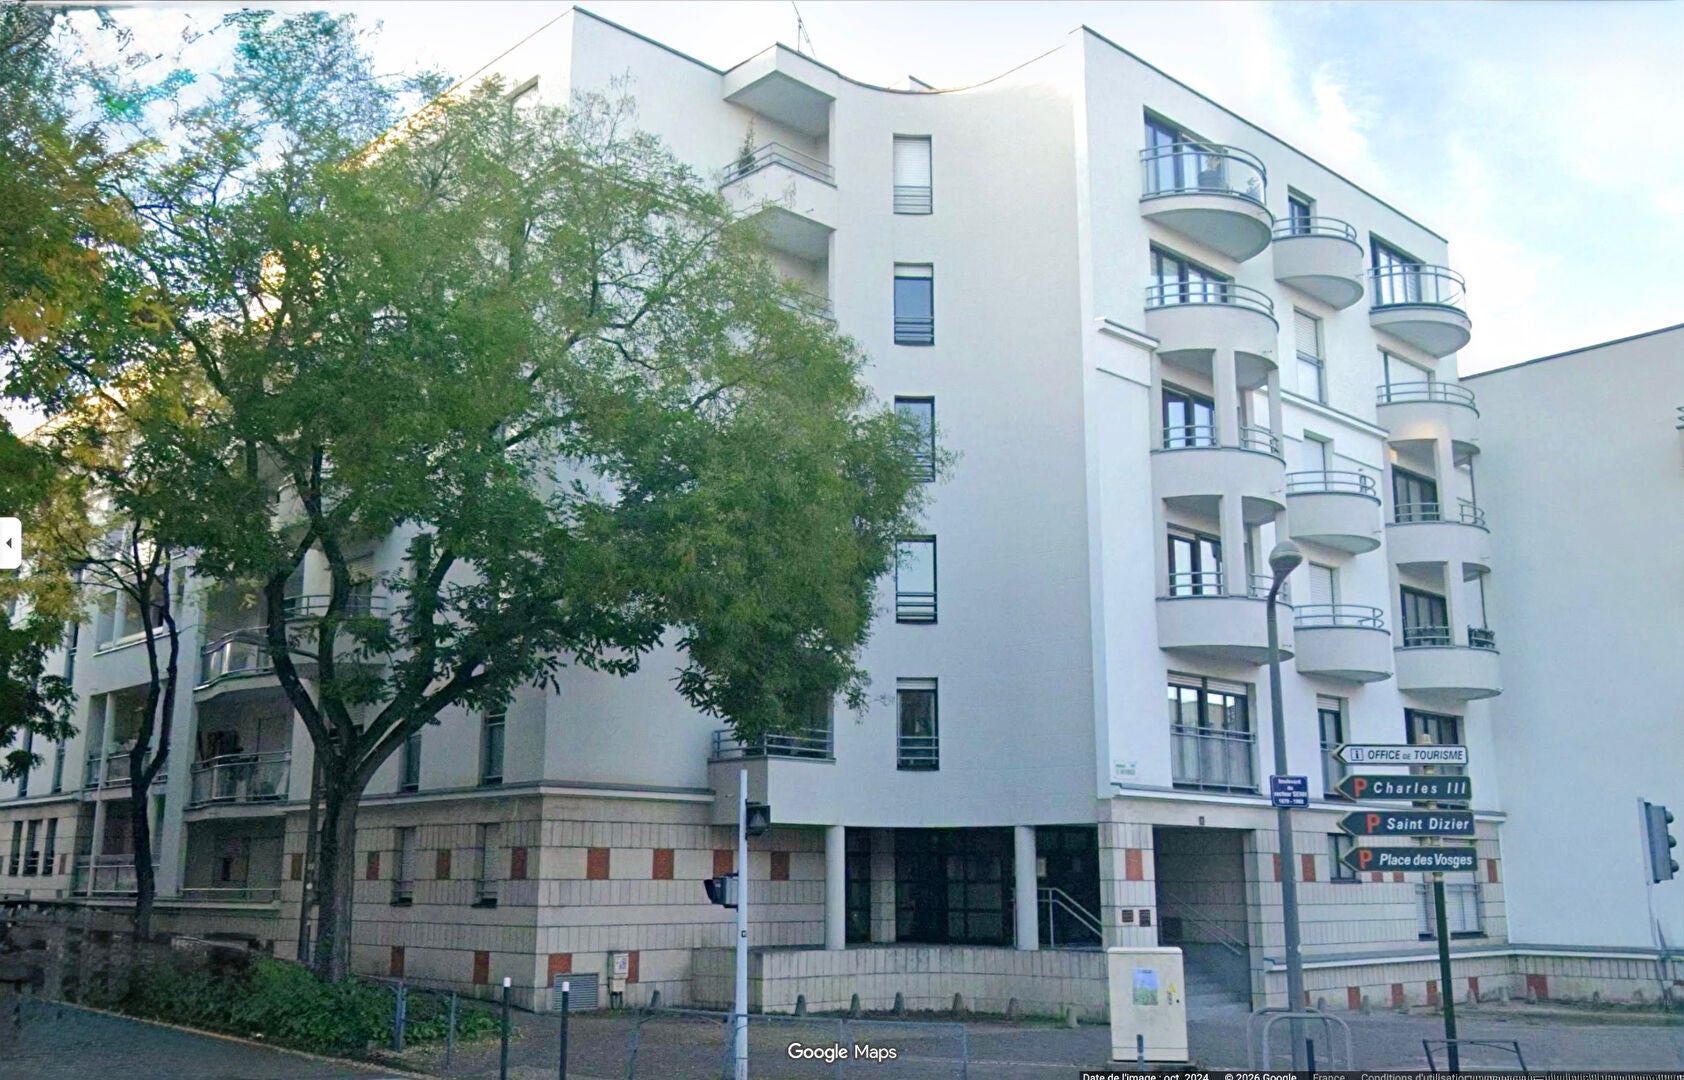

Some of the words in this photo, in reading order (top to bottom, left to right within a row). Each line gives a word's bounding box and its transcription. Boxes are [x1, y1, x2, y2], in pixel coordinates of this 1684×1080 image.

[1368, 750, 1400, 760] OFFICE
[1414, 750, 1463, 760] TOURISME
[1352, 777, 1367, 797] P
[1373, 782, 1438, 794] Charles
[1447, 781, 1466, 794] III
[1366, 813, 1380, 834] P
[1386, 818, 1423, 830] Saint
[1429, 818, 1470, 830] Dizier
[1358, 849, 1372, 869] P
[1379, 853, 1411, 866] Place
[1413, 854, 1433, 866] des
[1434, 853, 1473, 868] Vosges
